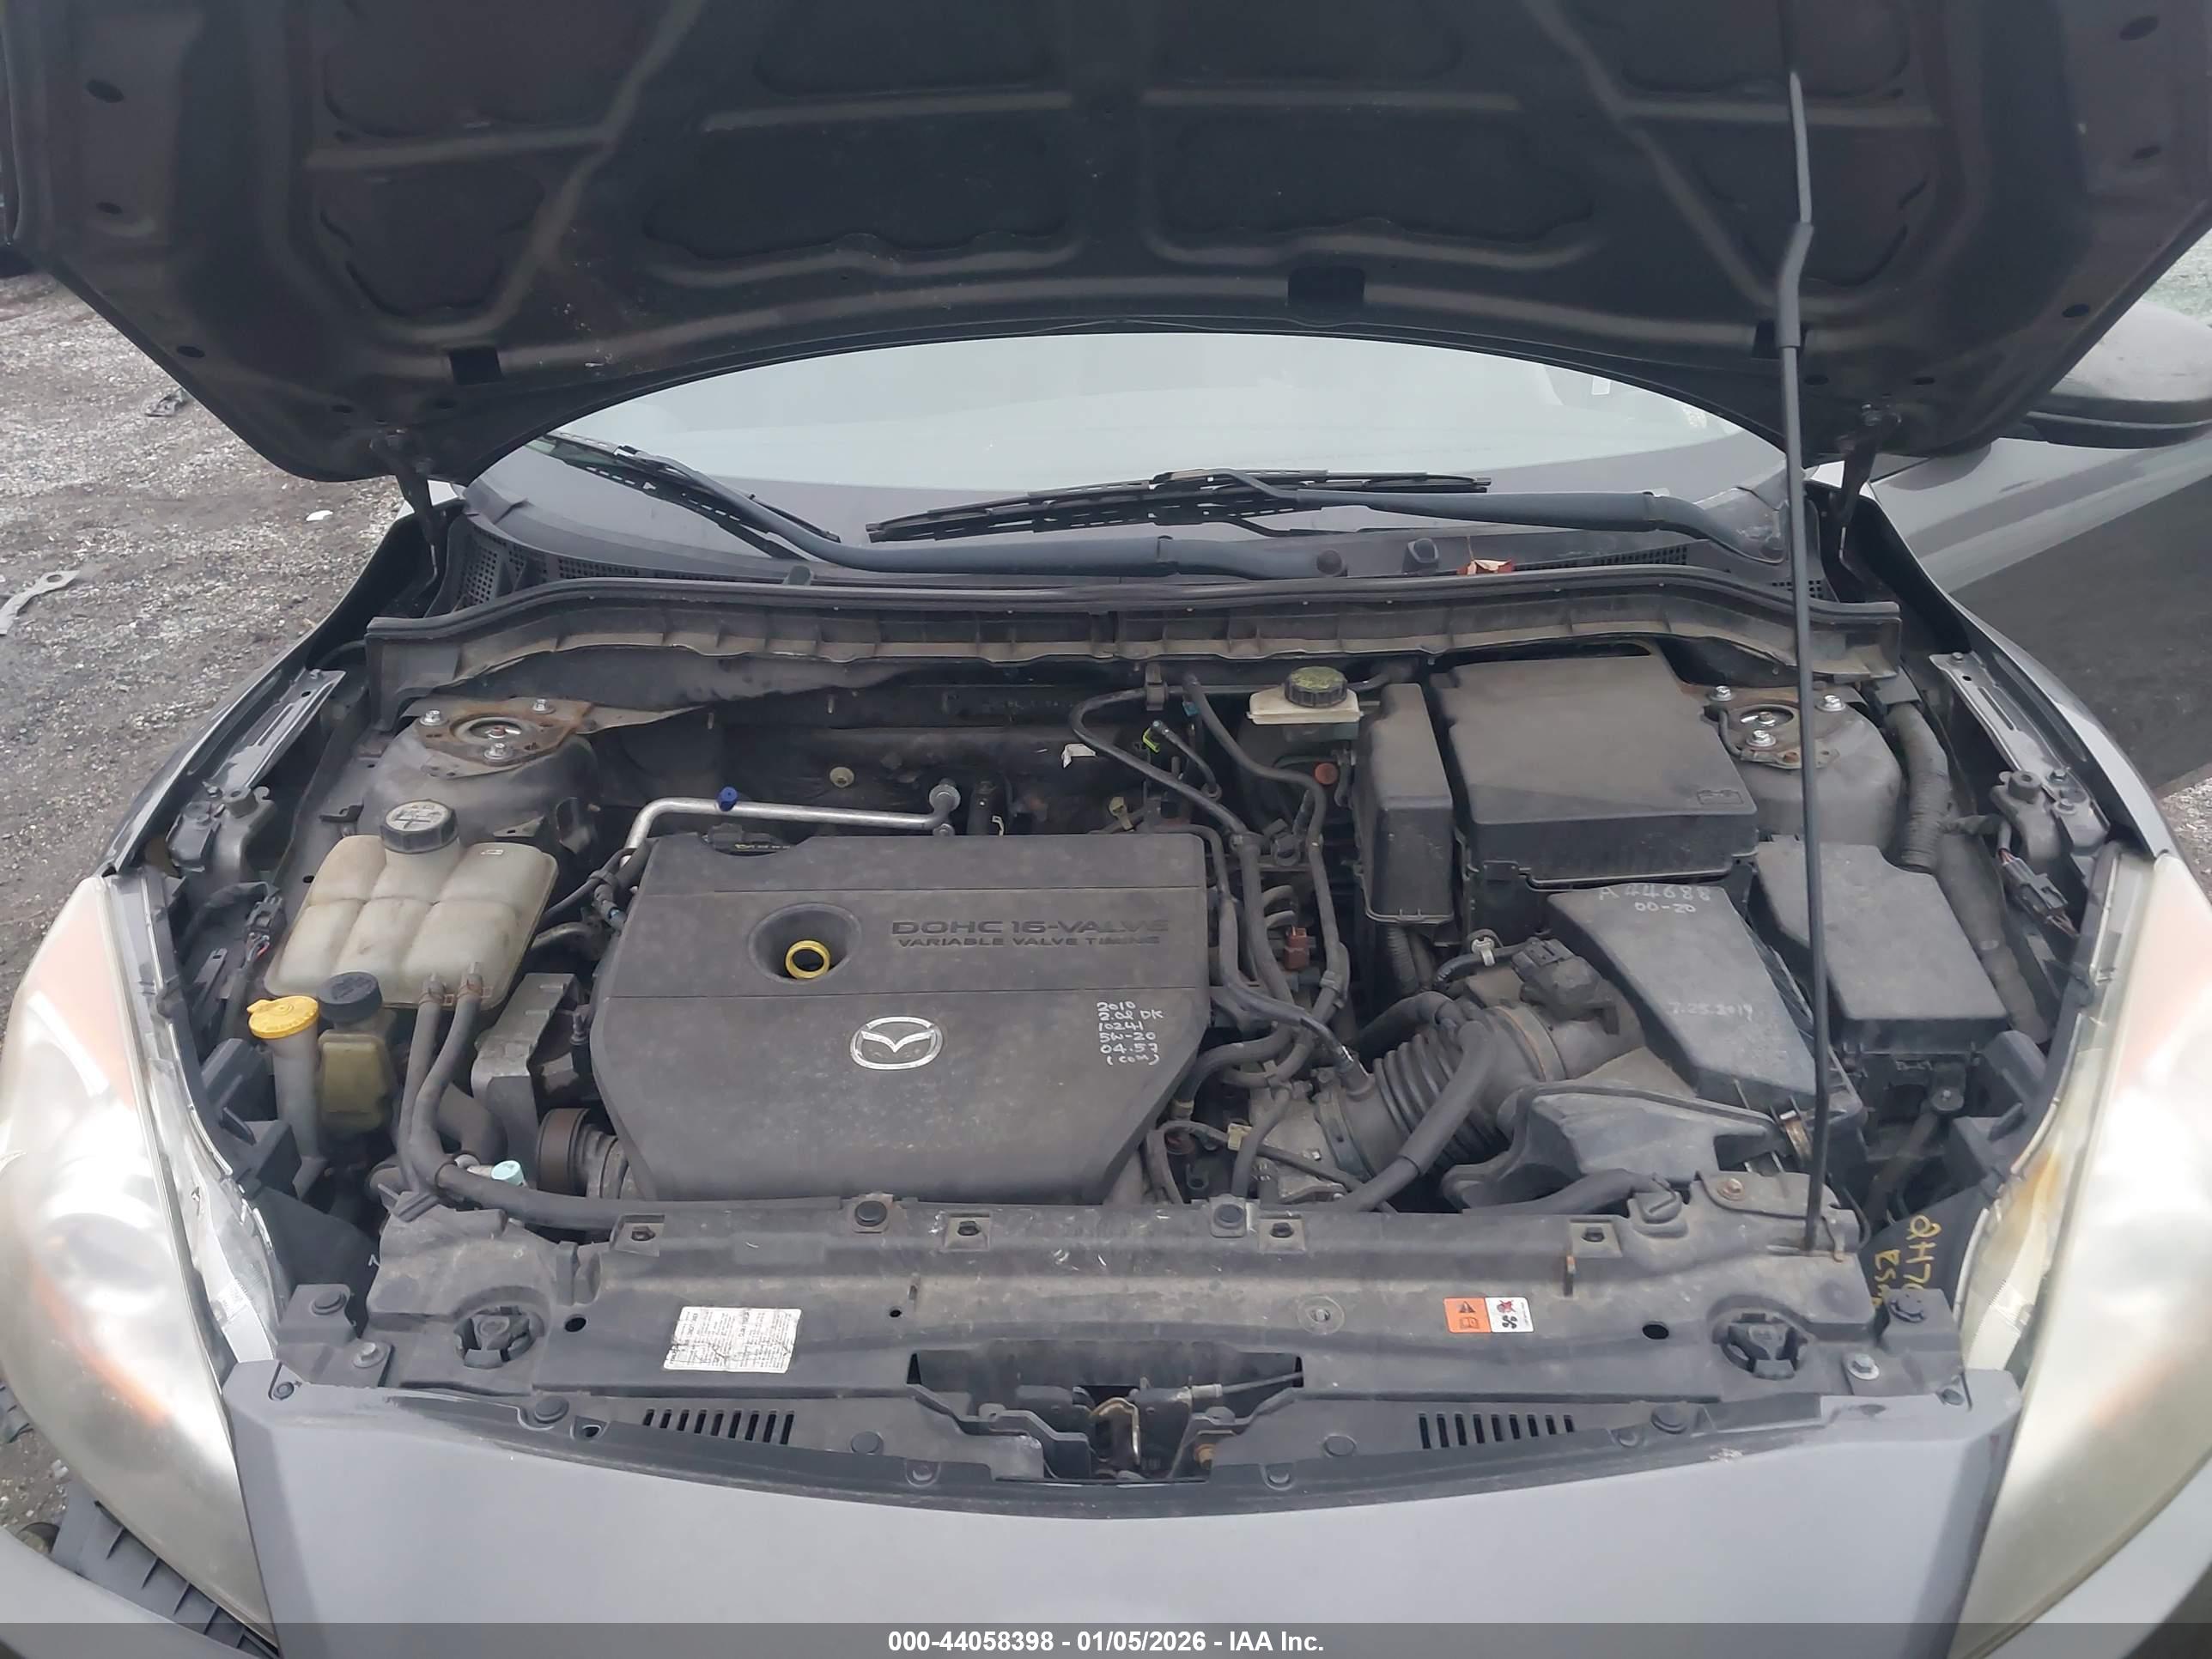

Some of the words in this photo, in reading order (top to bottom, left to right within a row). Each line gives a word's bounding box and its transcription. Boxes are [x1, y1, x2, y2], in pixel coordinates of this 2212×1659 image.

[891, 920, 1003, 935] DOHC
[1011, 919, 1169, 935] 16-VALVE
[898, 937, 1005, 948] VARIABLE
[1012, 936, 1079, 947] VALVE
[1096, 1000, 1136, 1012] 2010
